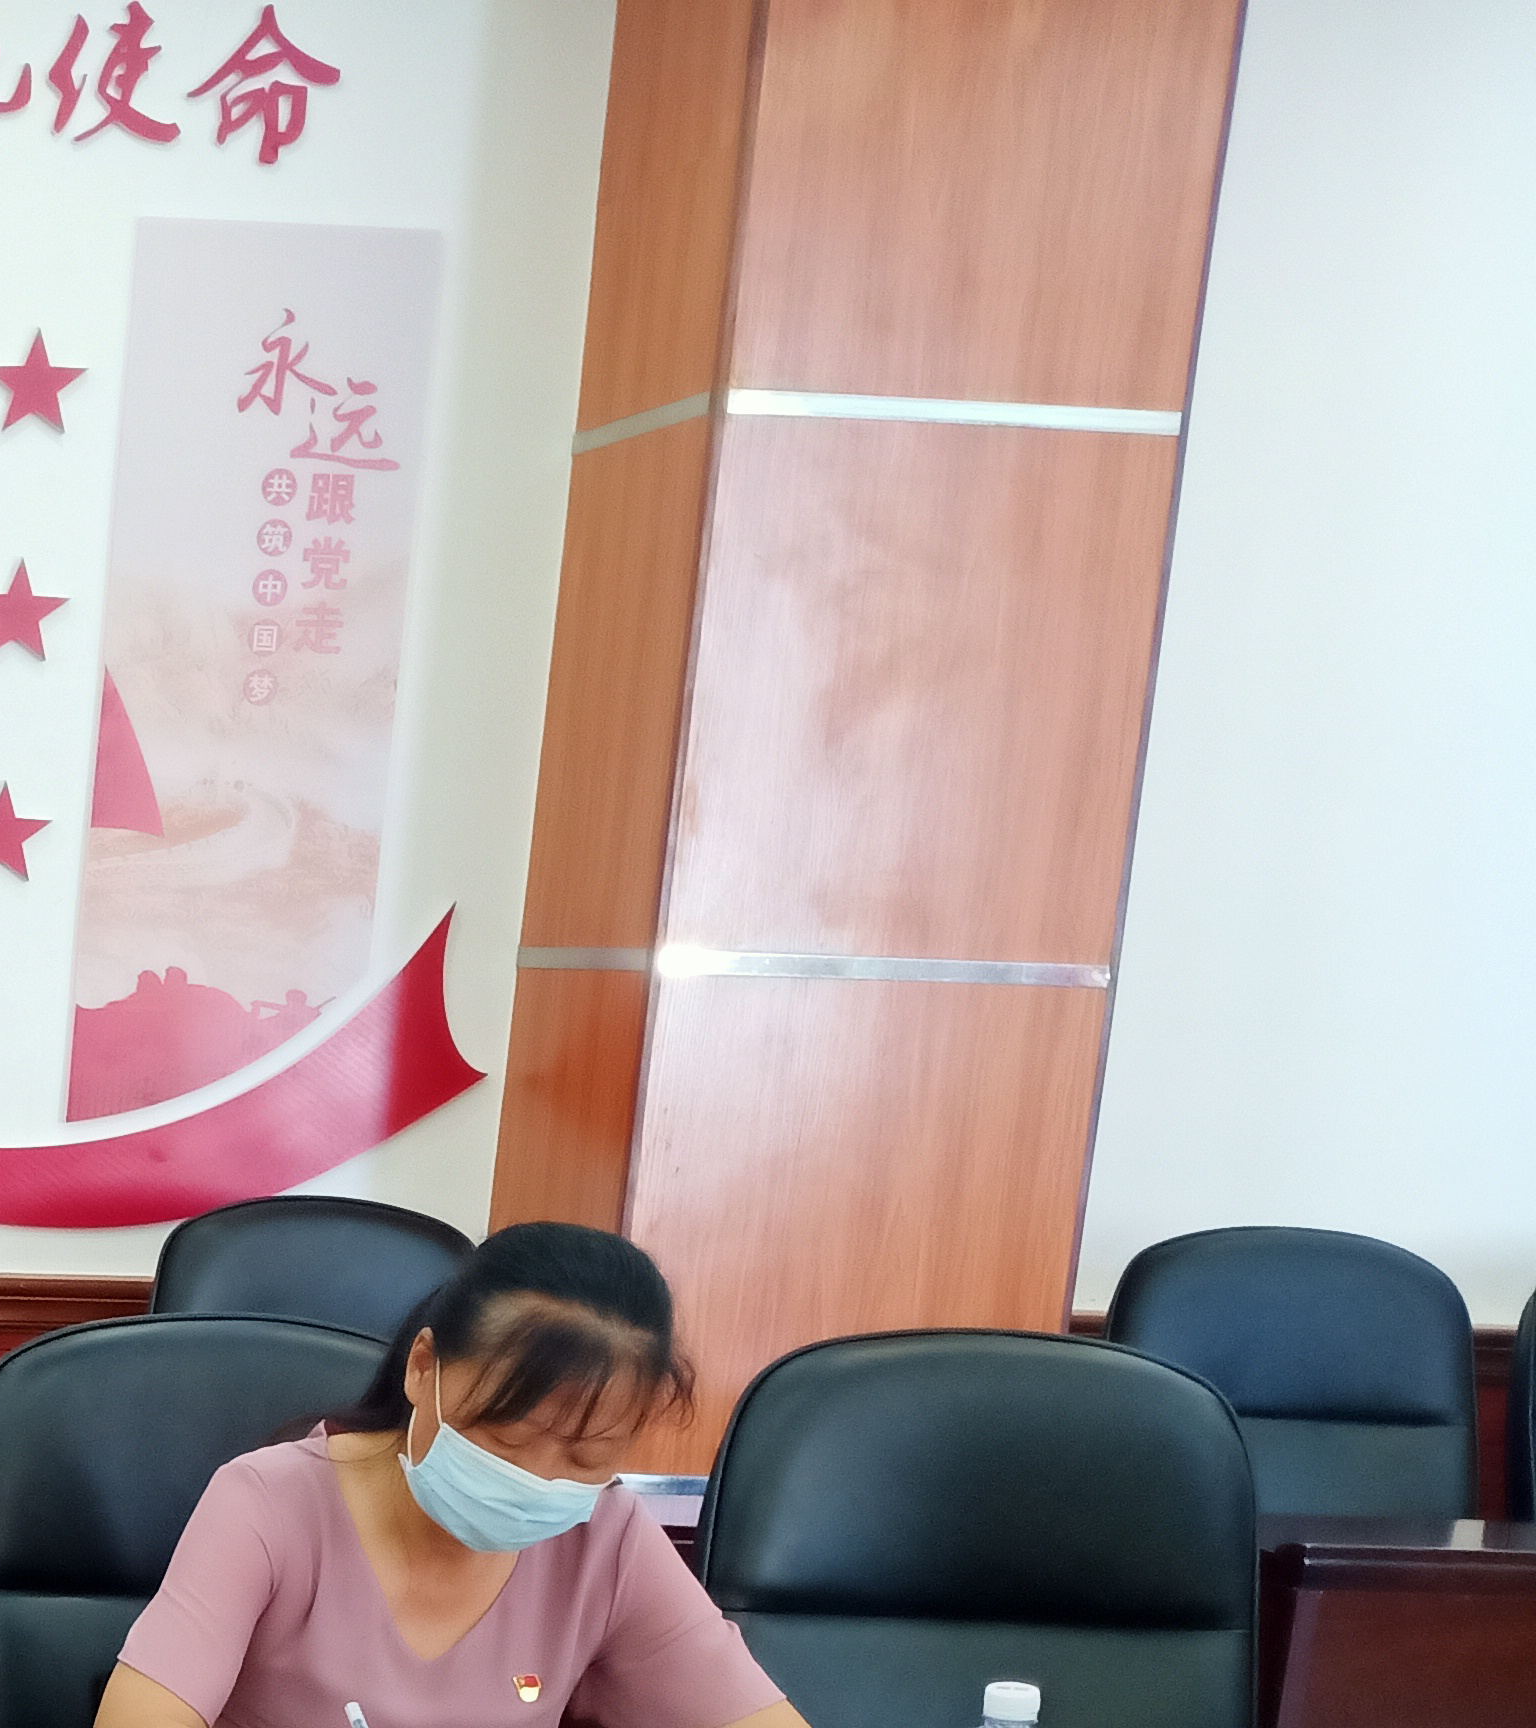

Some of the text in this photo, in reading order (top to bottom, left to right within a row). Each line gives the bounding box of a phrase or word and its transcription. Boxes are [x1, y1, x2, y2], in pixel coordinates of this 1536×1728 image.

[236, 307, 401, 472] 永远
[244, 469, 298, 706] 共筑中国梦
[292, 472, 356, 655] 跟党走
